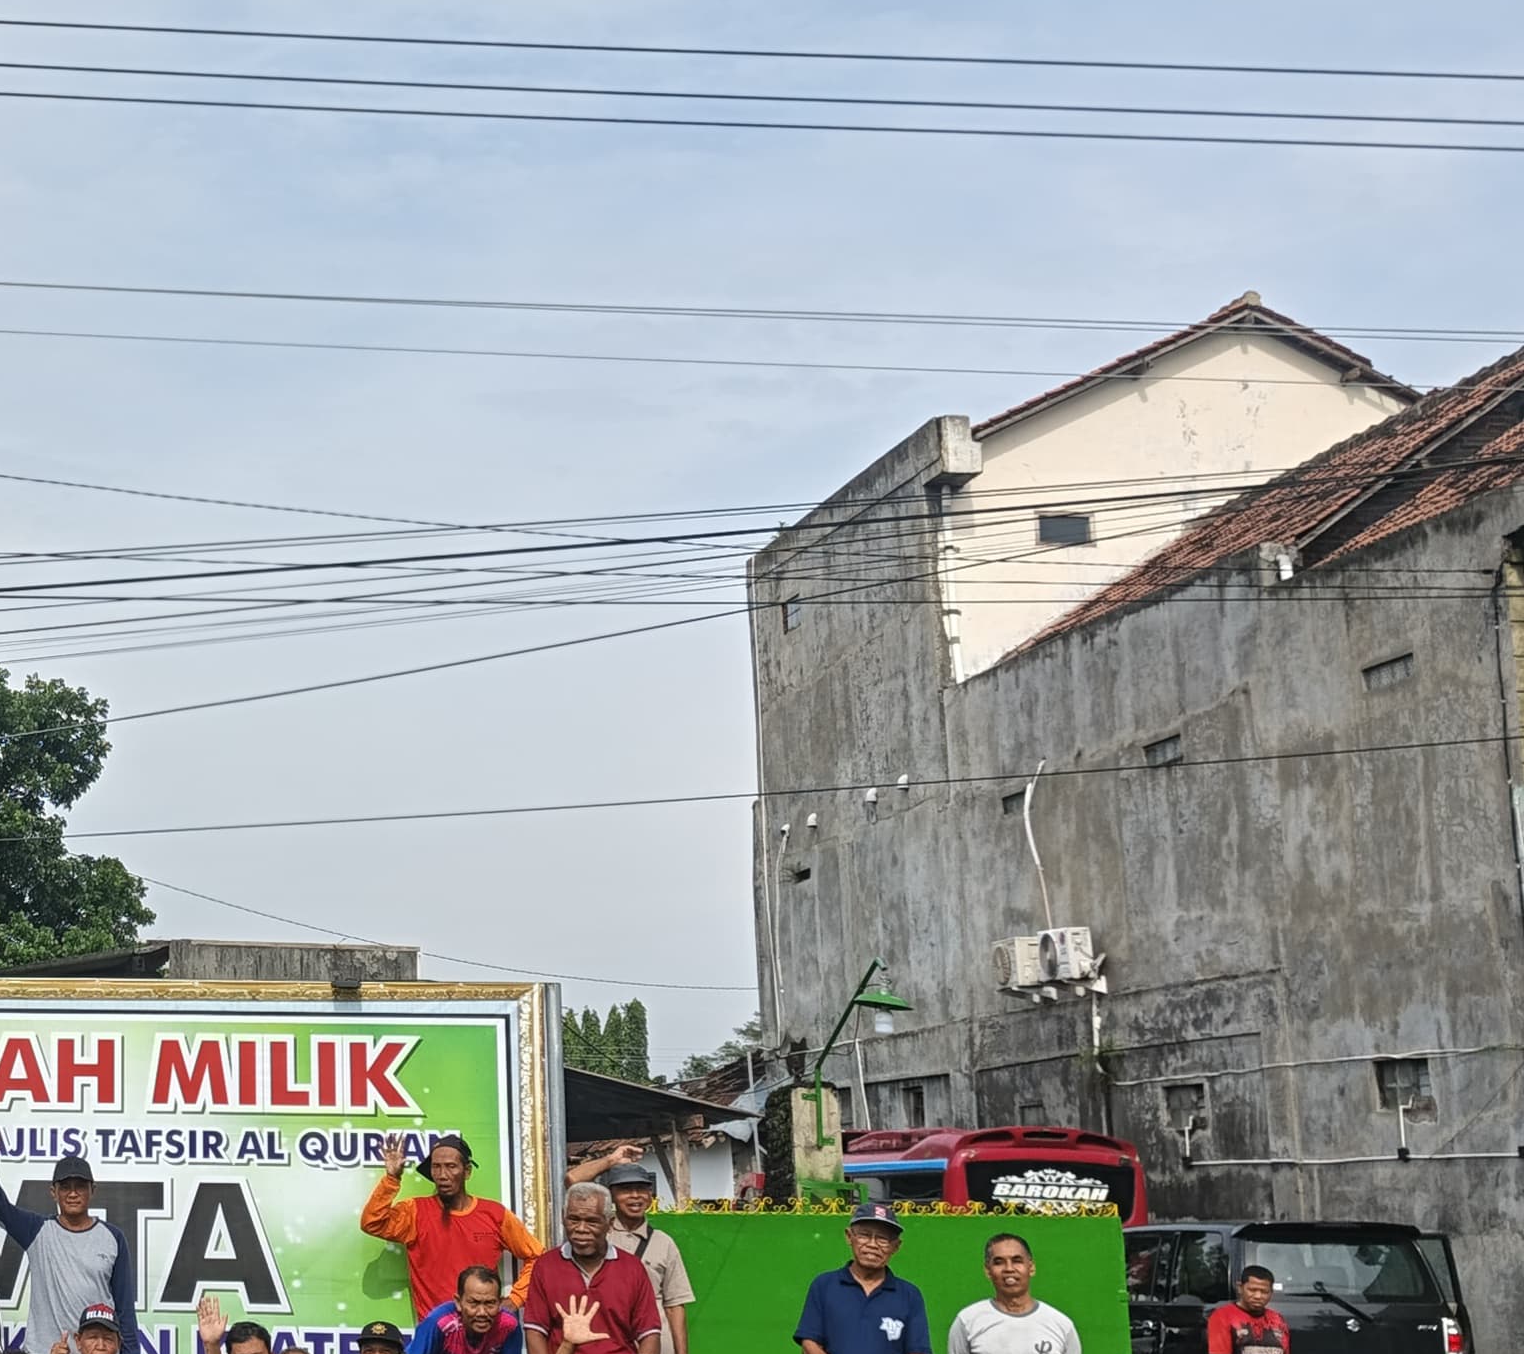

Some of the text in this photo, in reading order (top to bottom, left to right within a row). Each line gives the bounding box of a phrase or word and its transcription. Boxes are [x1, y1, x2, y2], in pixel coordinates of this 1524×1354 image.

[151, 1038, 414, 1110] MILIK
[95, 1129, 224, 1160] TAFSIR
[235, 1132, 285, 1161] AL
[298, 1131, 446, 1164] QURA
[992, 1183, 1110, 1202] BAROKAH
